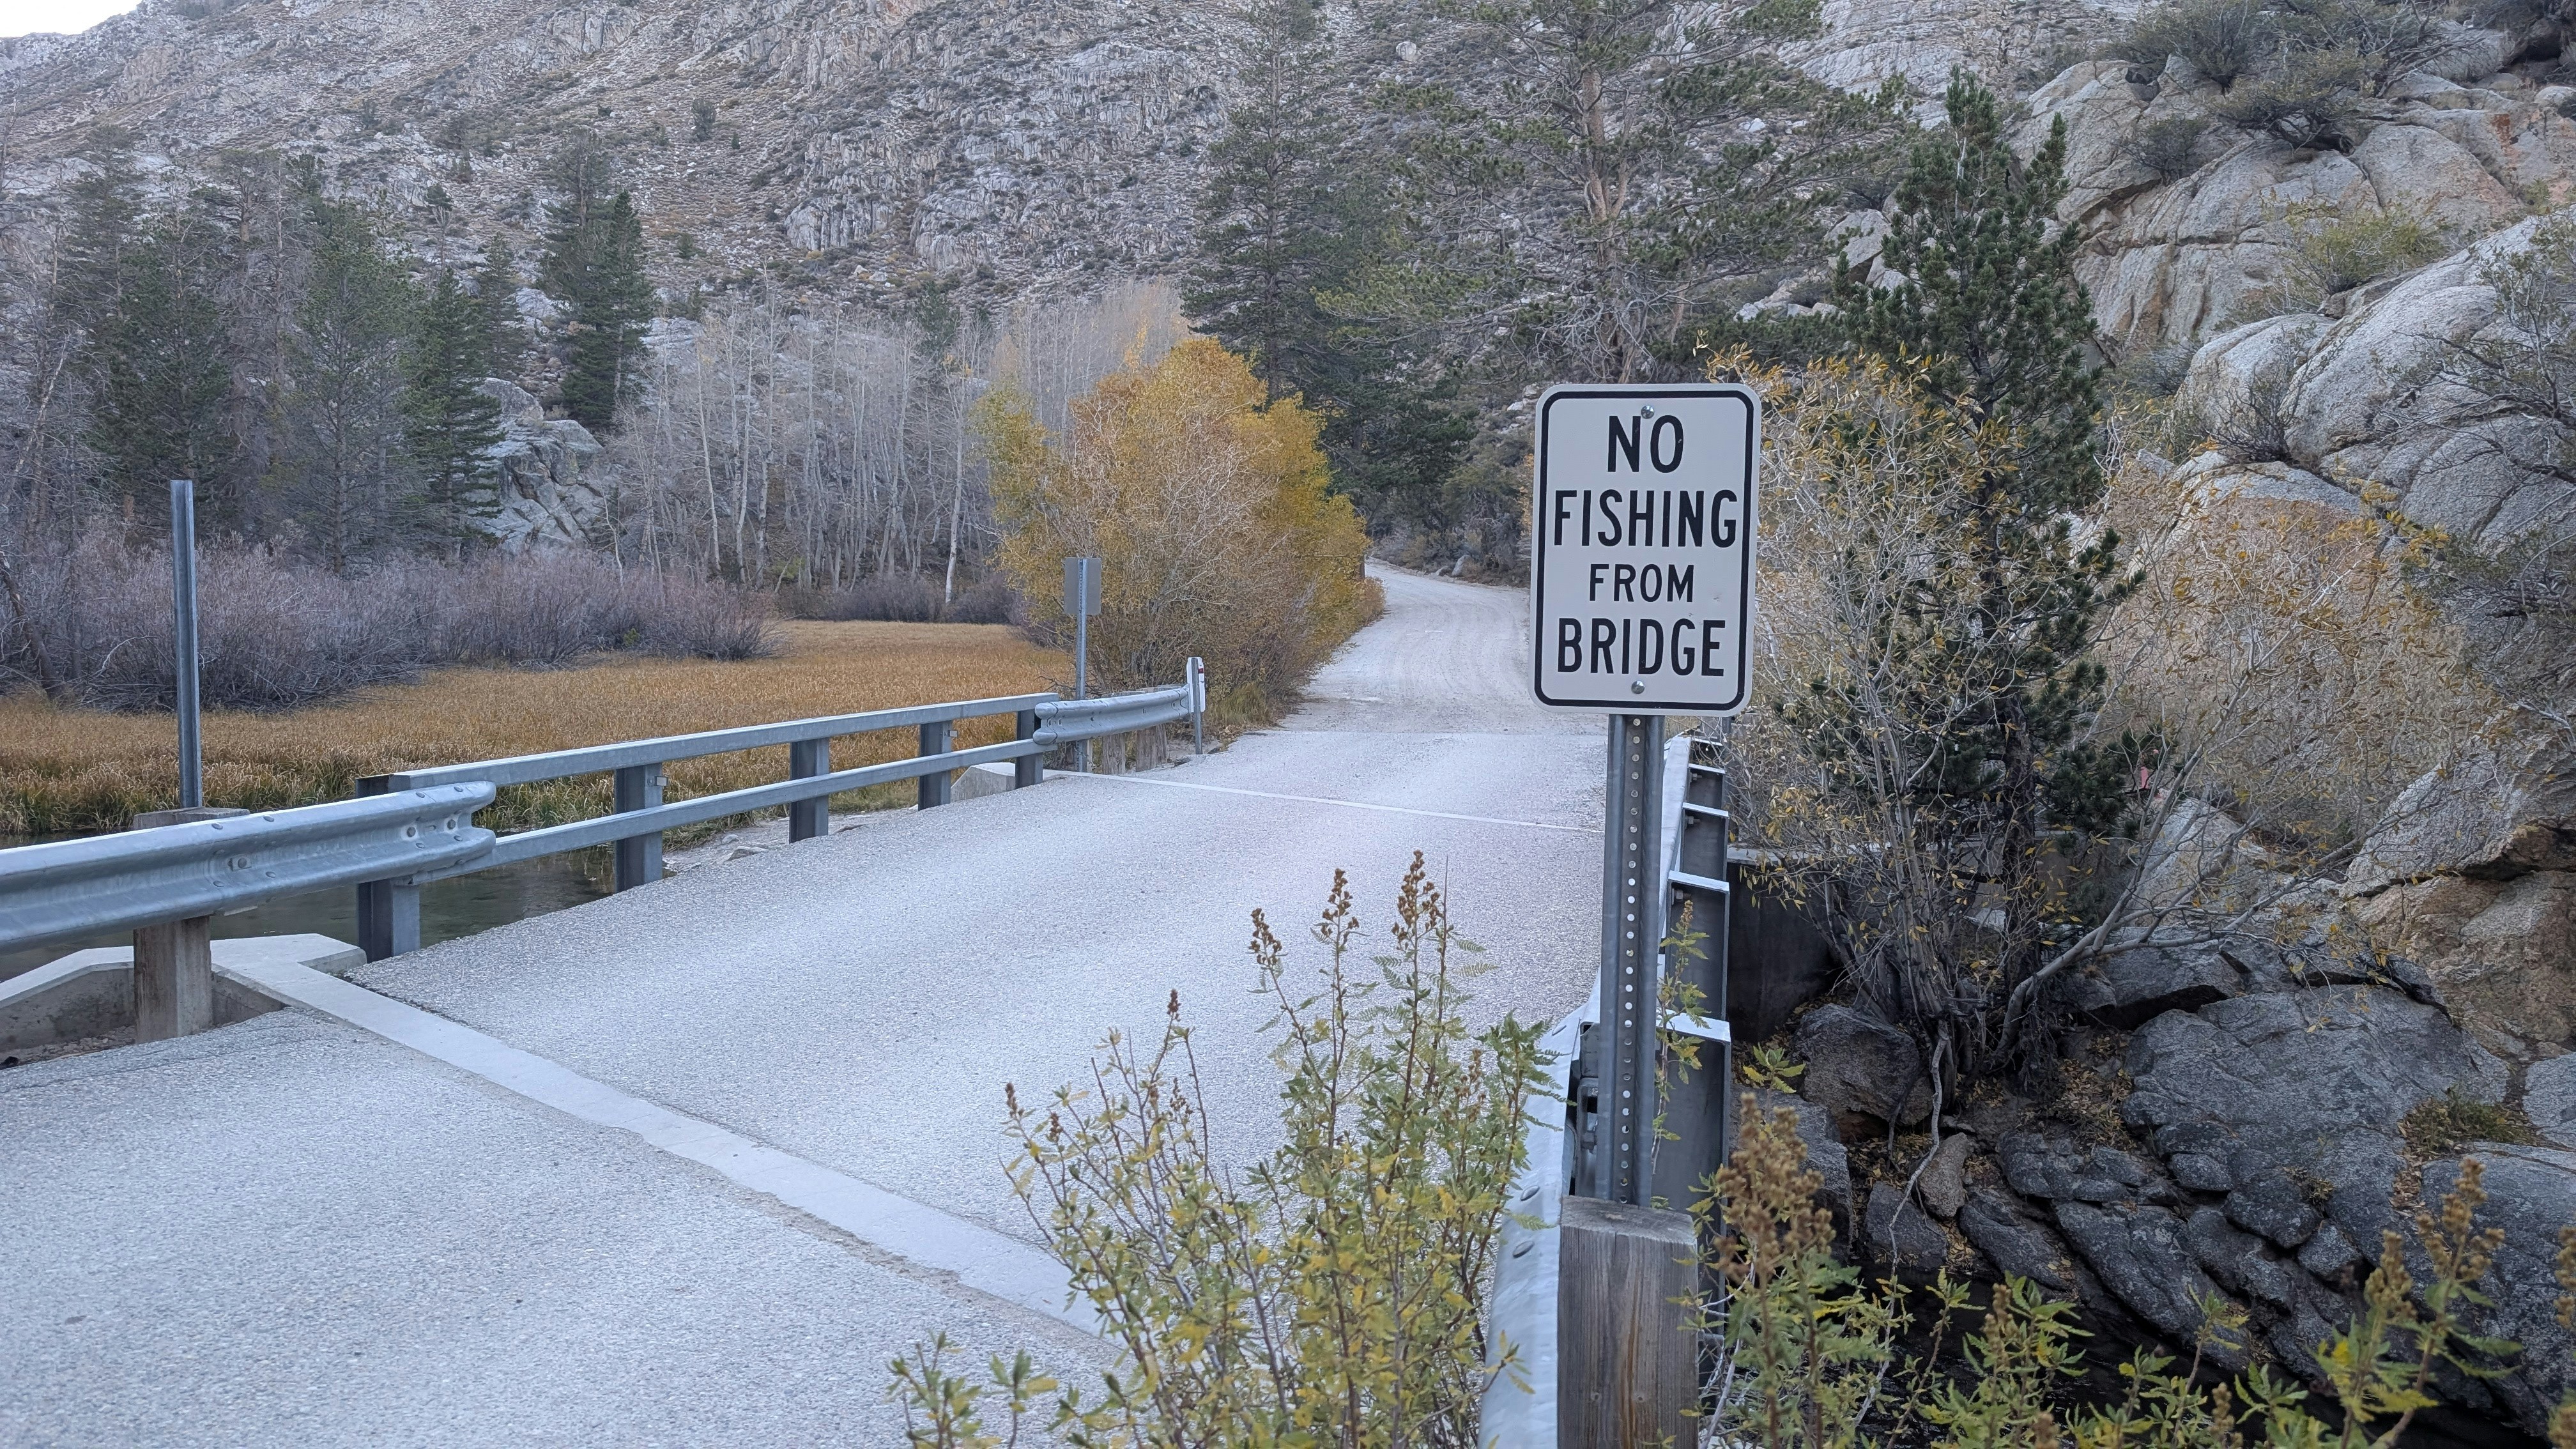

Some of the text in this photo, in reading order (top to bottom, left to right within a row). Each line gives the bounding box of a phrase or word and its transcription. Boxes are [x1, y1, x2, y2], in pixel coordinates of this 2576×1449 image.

[1607, 415, 1684, 473] NO
[1554, 489, 1738, 548] FISHING
[1589, 564, 1695, 602] FROM
[1557, 617, 1726, 677] BRIDGE
